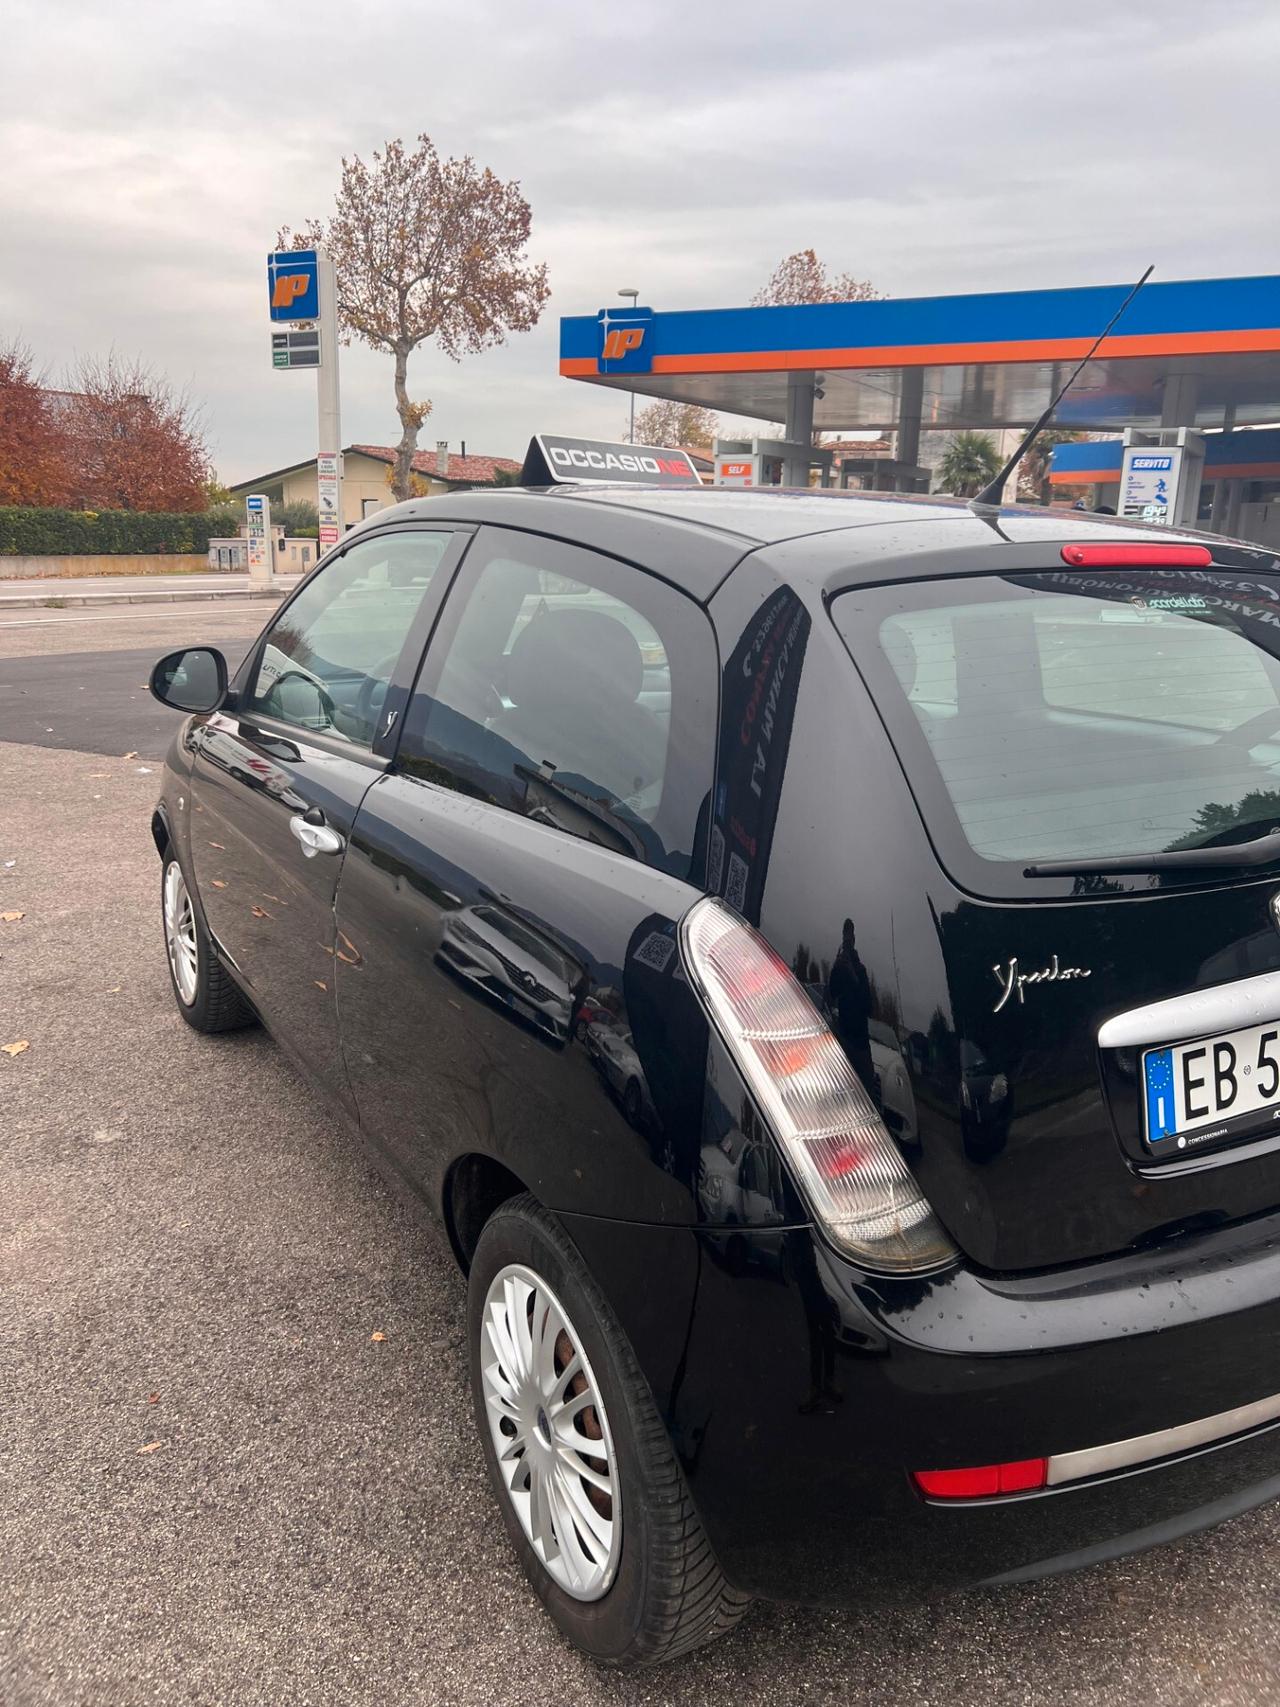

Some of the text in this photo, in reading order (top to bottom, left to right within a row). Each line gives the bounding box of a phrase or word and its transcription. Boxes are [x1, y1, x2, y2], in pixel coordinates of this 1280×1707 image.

[602, 328, 645, 359] IP
[549, 447, 693, 478] OCCASIONE
[727, 465, 745, 474] SELF
[1132, 458, 1170, 469] SERVITO
[1182, 1041, 1238, 1121] EB
